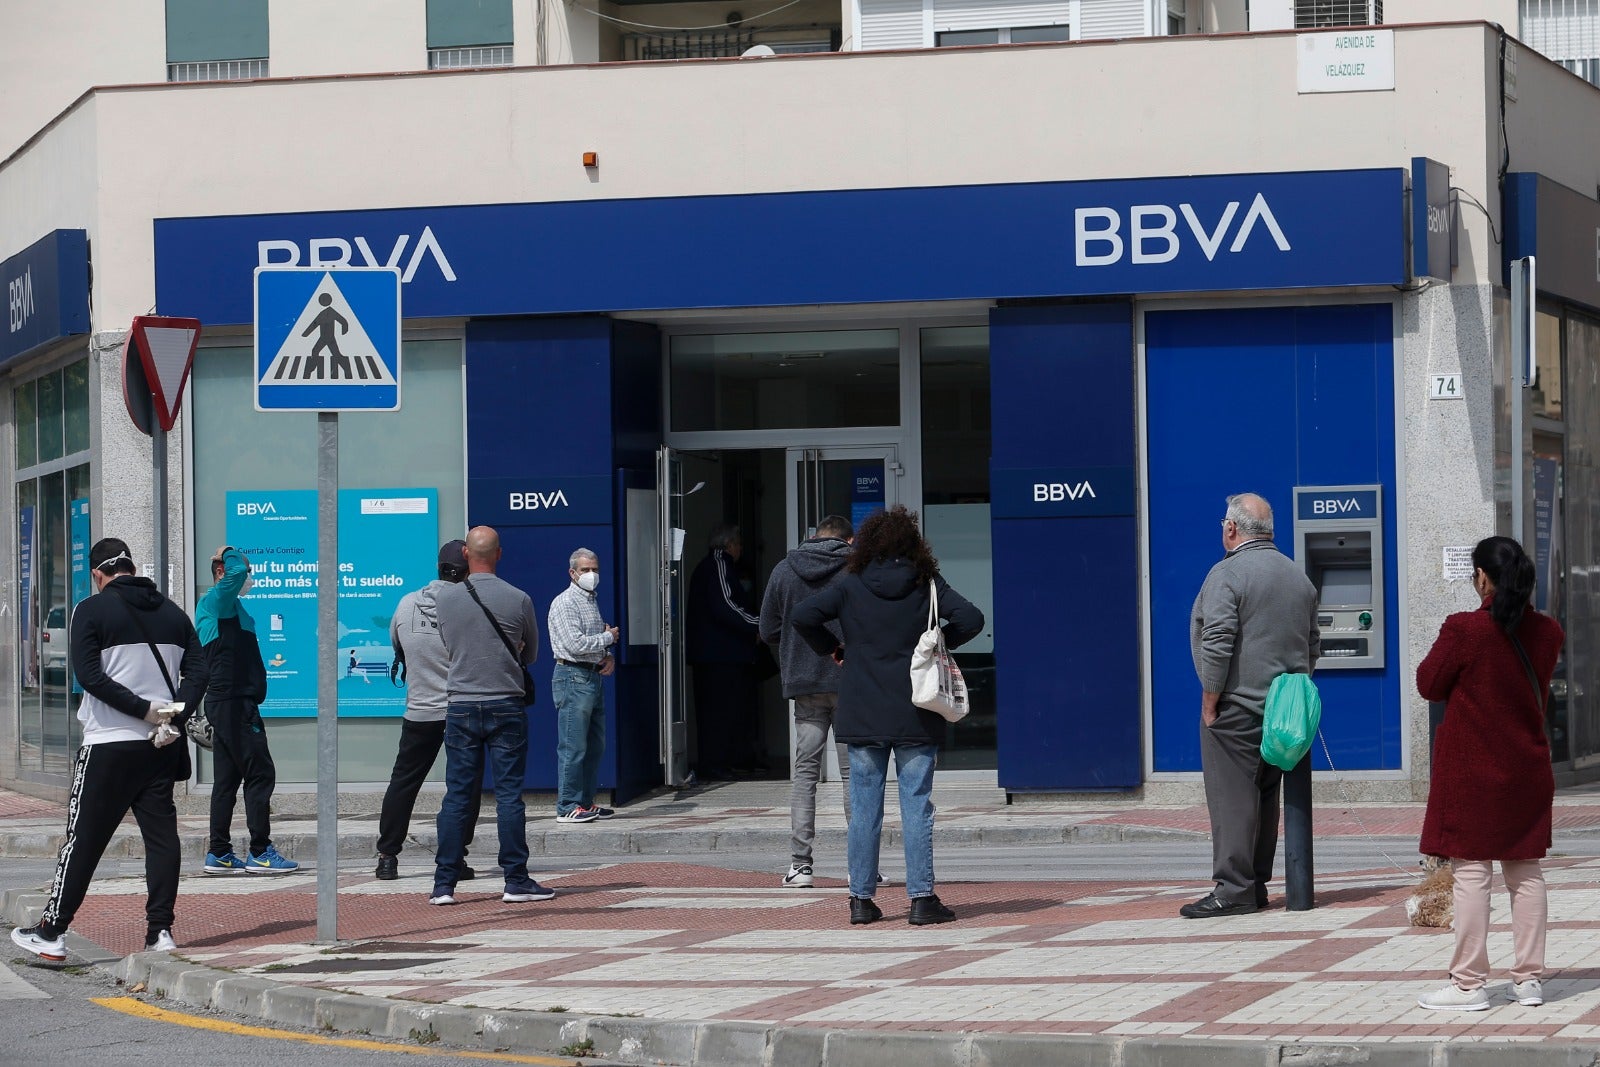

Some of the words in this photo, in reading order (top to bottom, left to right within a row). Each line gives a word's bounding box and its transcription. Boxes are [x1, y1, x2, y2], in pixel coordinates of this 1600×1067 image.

[1335, 36, 1364, 49] AVENIDA
[1365, 35, 1375, 48] DE
[1427, 204, 1449, 234] BBVA
[1075, 192, 1291, 267] BBVA
[9, 263, 35, 333] BBVA
[1437, 377, 1456, 395] 74
[857, 476, 879, 485] BBVA
[509, 489, 569, 510] BBVA
[1034, 480, 1097, 502] BBVA
[237, 501, 277, 515] BBVA
[1313, 497, 1361, 514] BBVA
[276, 546, 305, 555] Contigo
[248, 560, 268, 576] quí
[270, 561, 284, 573] tu
[287, 559, 319, 573] nómi
[339, 562, 354, 572] es
[251, 576, 282, 588] ucho
[284, 575, 312, 587] más
[342, 575, 357, 587] tu
[359, 574, 404, 587] sueldo
[51, 865, 64, 898] adidas
